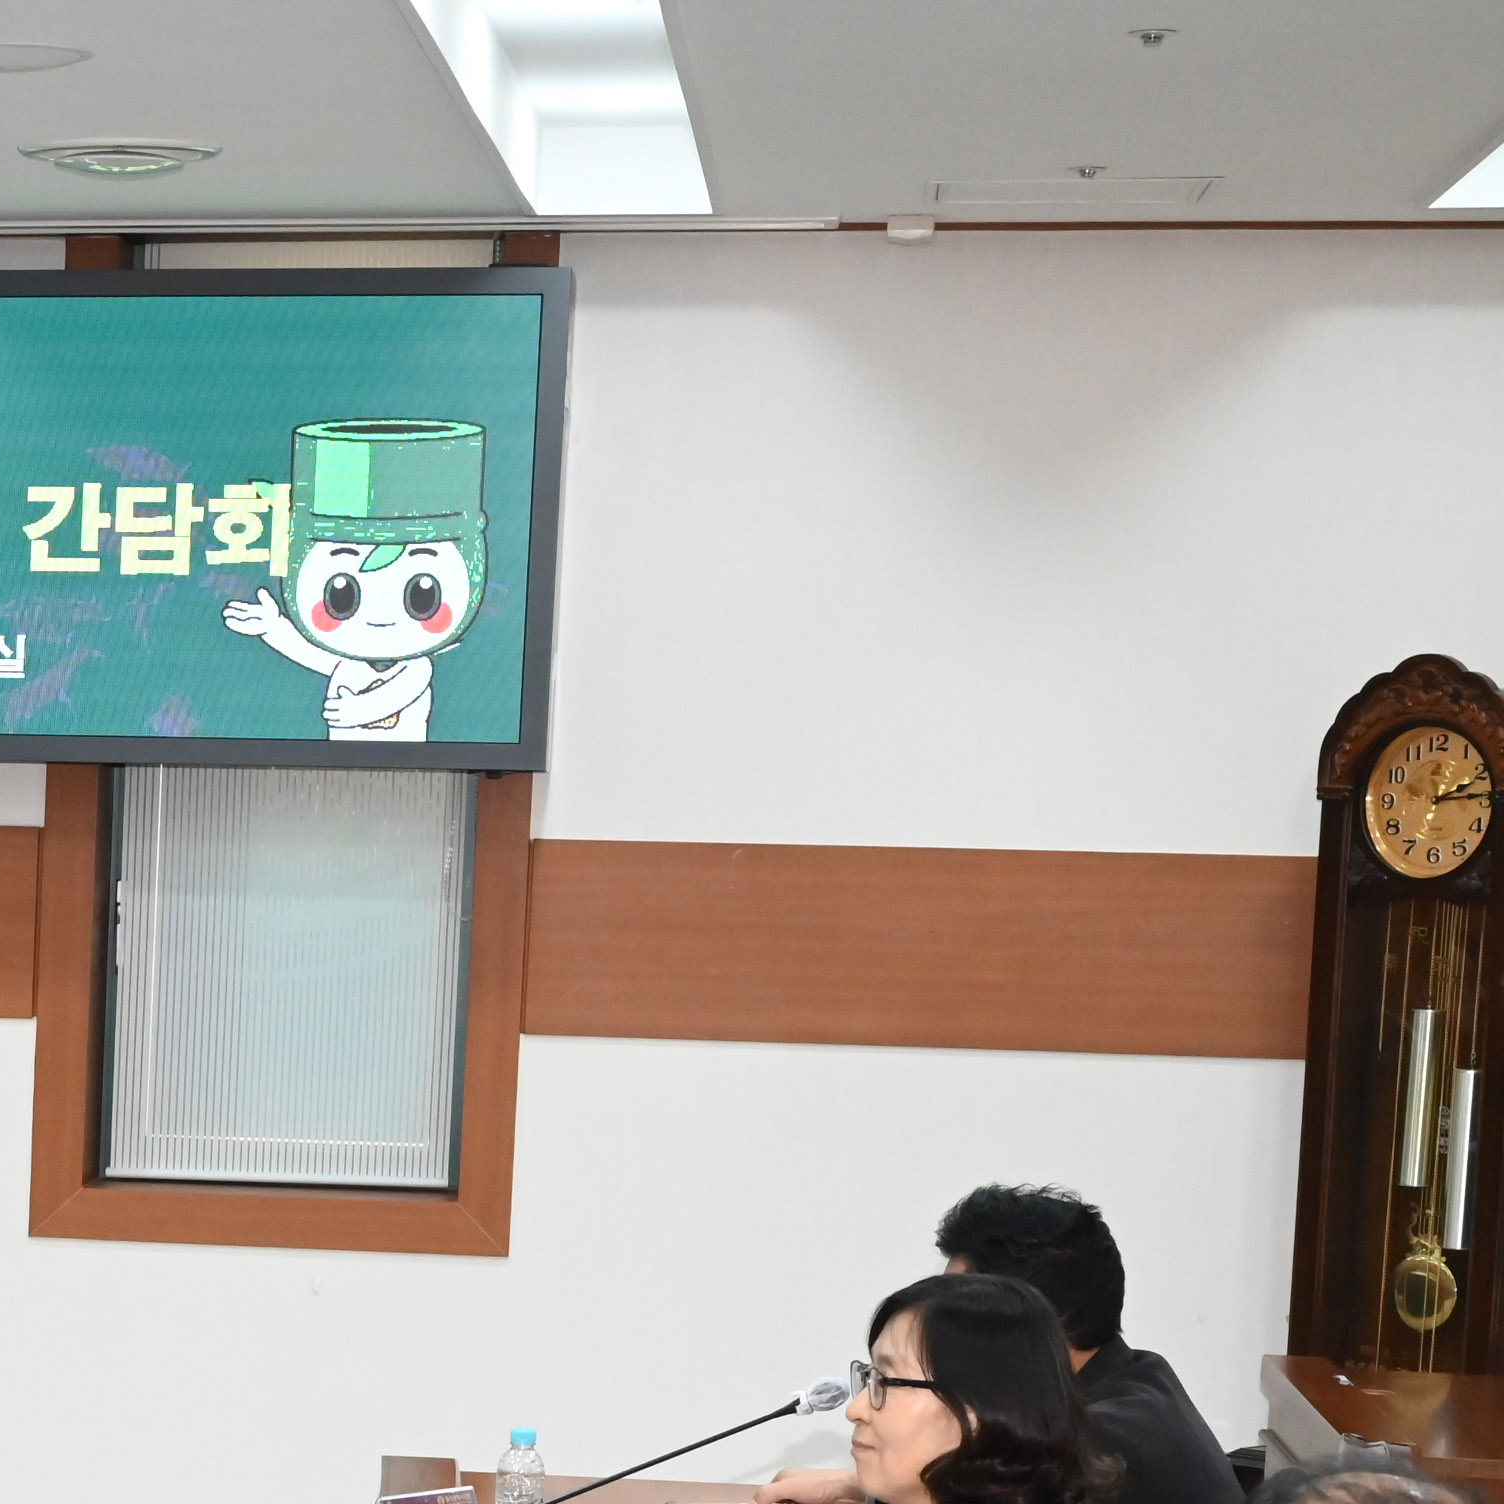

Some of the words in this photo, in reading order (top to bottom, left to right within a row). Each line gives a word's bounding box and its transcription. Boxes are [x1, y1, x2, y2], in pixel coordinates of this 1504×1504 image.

[22, 480, 294, 578] 간담회
[1405, 743, 1423, 762] 11
[1428, 733, 1450, 753] 12
[1388, 766, 1406, 785] 10
[1381, 793, 1395, 810] 9
[1385, 818, 1401, 836] 8
[1468, 816, 1484, 834] 4
[1402, 839, 1418, 856] 7
[1426, 846, 1441, 865] 6
[1452, 838, 1468, 857] 5
